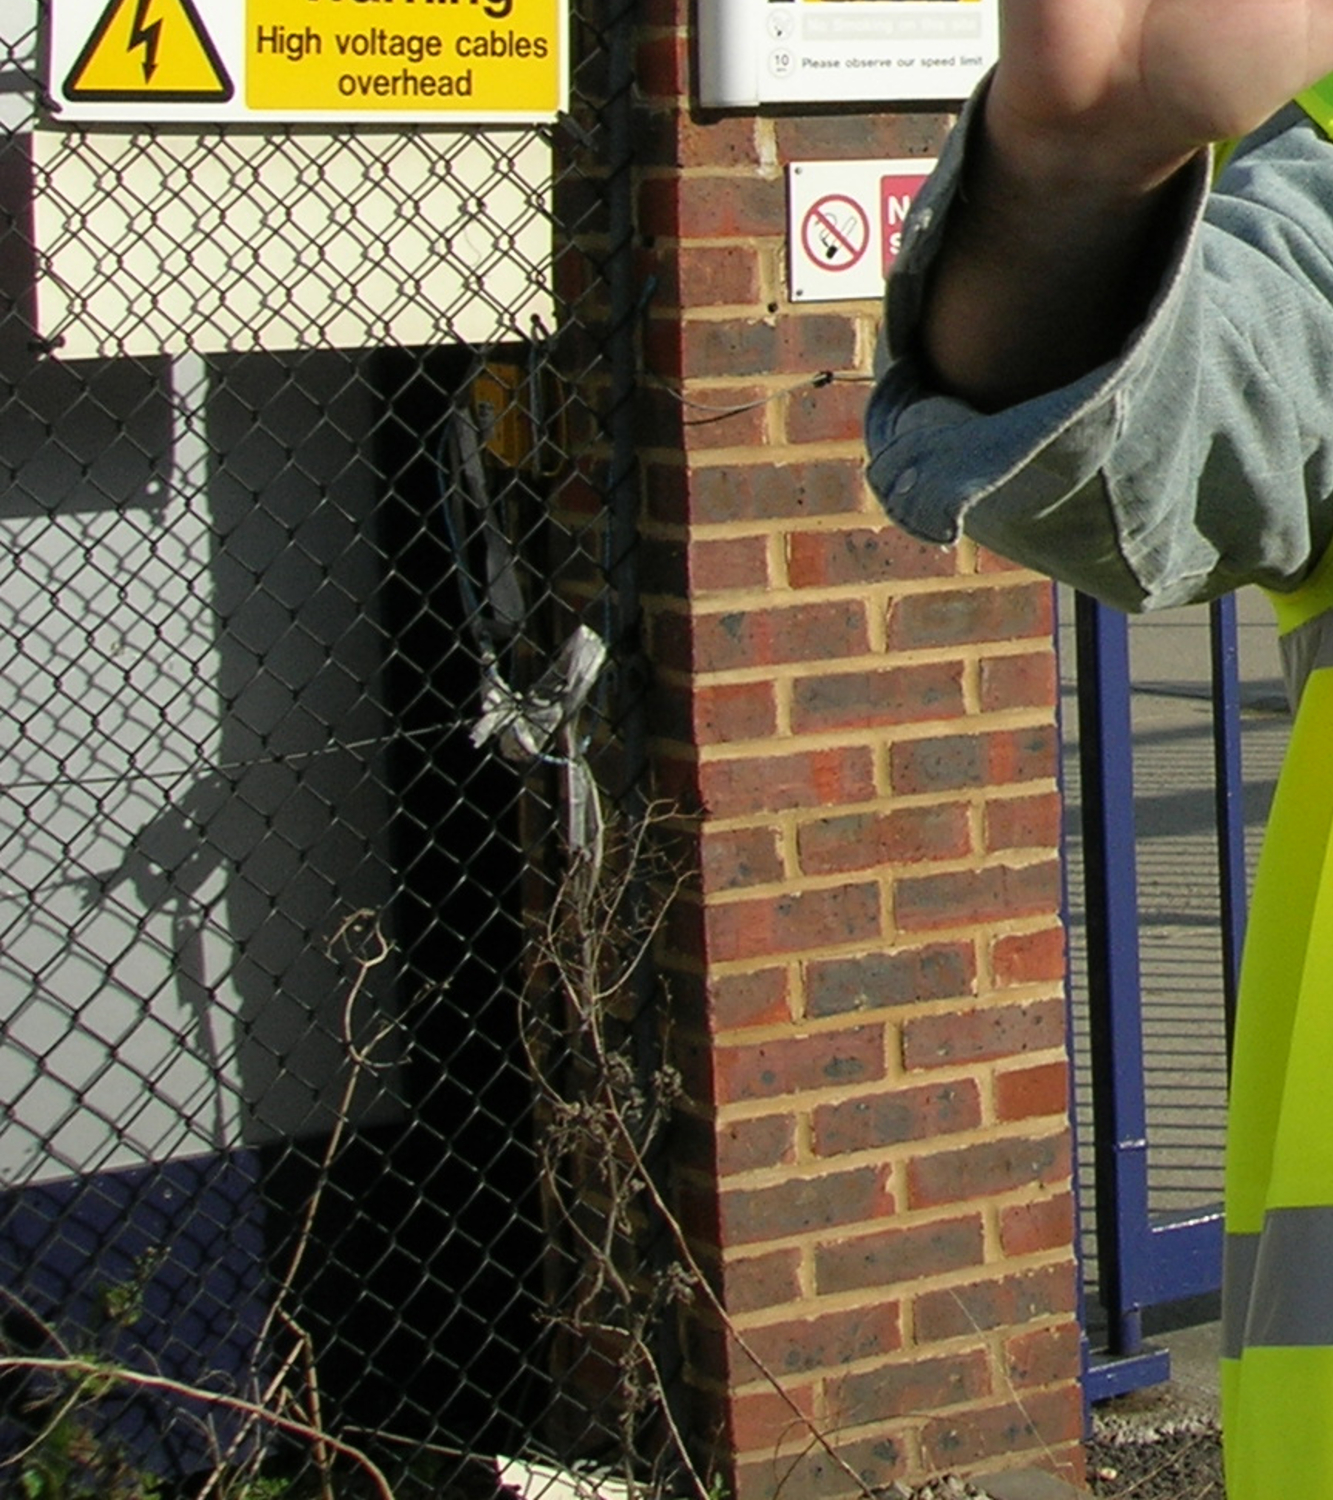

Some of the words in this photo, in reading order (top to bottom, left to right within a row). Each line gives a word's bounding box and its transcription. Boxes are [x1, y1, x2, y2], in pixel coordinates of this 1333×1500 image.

[256, 25, 323, 61] High
[335, 27, 443, 63] voltage
[455, 29, 549, 58] cables
[774, 54, 790, 67] 10
[801, 57, 841, 69] Please
[844, 56, 892, 68] observe
[897, 58, 916, 67] our
[920, 56, 956, 68] speed
[959, 55, 983, 66] limit
[338, 68, 473, 97] overhead
[888, 195, 912, 225] N
